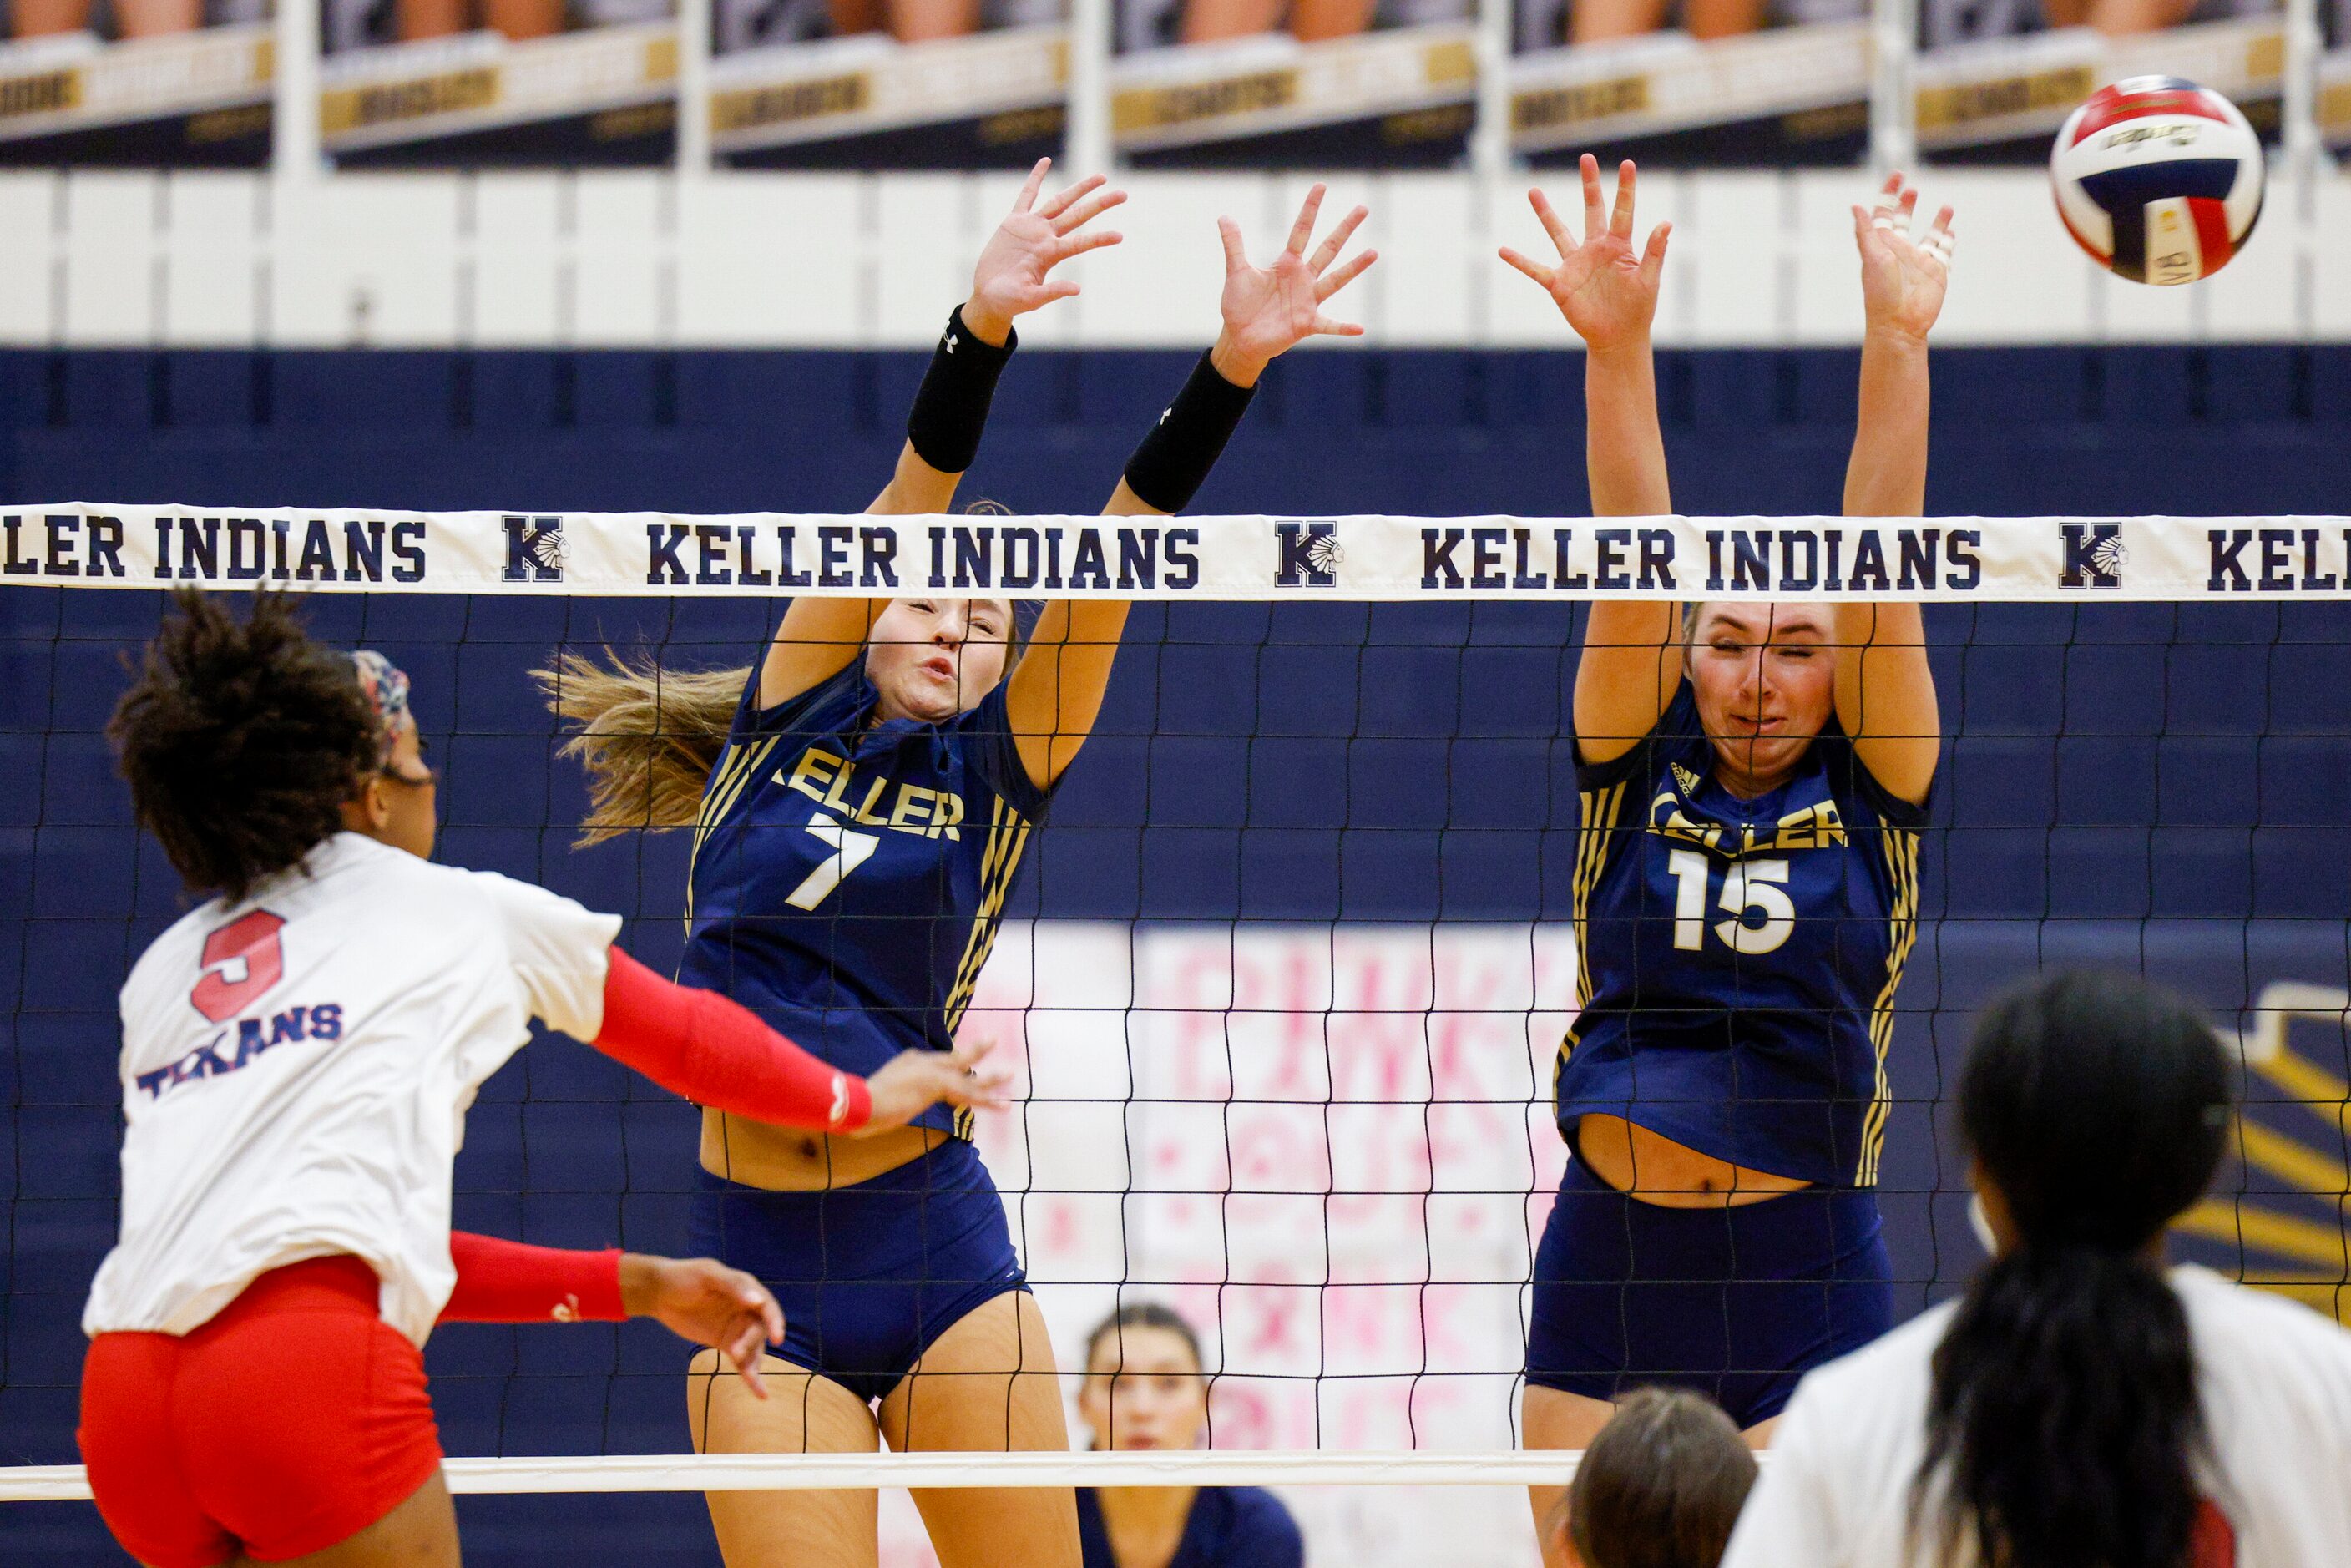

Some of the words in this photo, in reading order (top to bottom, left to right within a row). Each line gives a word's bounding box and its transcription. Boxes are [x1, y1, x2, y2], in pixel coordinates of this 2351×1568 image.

[3, 515, 125, 576] LER
[154, 518, 426, 583] INDIANS
[502, 515, 564, 583] K
[646, 524, 899, 588] KELLER
[928, 526, 1199, 589] INDIANS
[1274, 520, 1337, 588] K
[1421, 528, 1676, 590] KELLER
[1706, 529, 1981, 591] INDIANS
[2057, 522, 2121, 590] K
[2207, 529, 2351, 591] KEL
[784, 812, 880, 912] 7
[1668, 848, 1796, 955] 15
[135, 1003, 343, 1101] TEXANS
